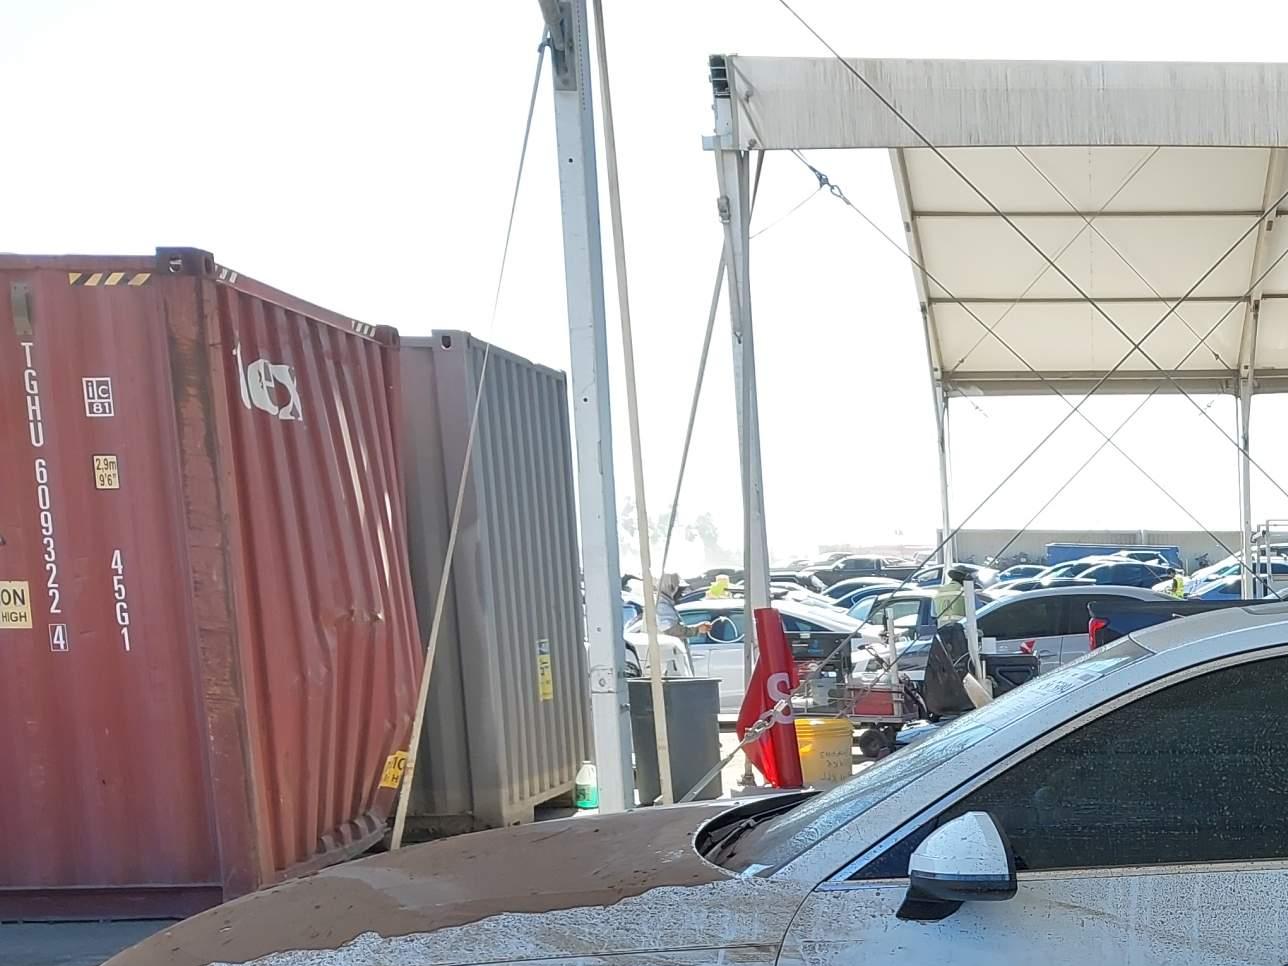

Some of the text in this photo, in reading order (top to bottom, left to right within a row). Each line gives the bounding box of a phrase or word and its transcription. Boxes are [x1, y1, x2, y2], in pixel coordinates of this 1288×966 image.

[93, 402, 110, 414] 81
[20, 342, 66, 650] TGHU 609322 4
[2, 611, 28, 623] HIGH
[111, 549, 130, 652] 45G1
